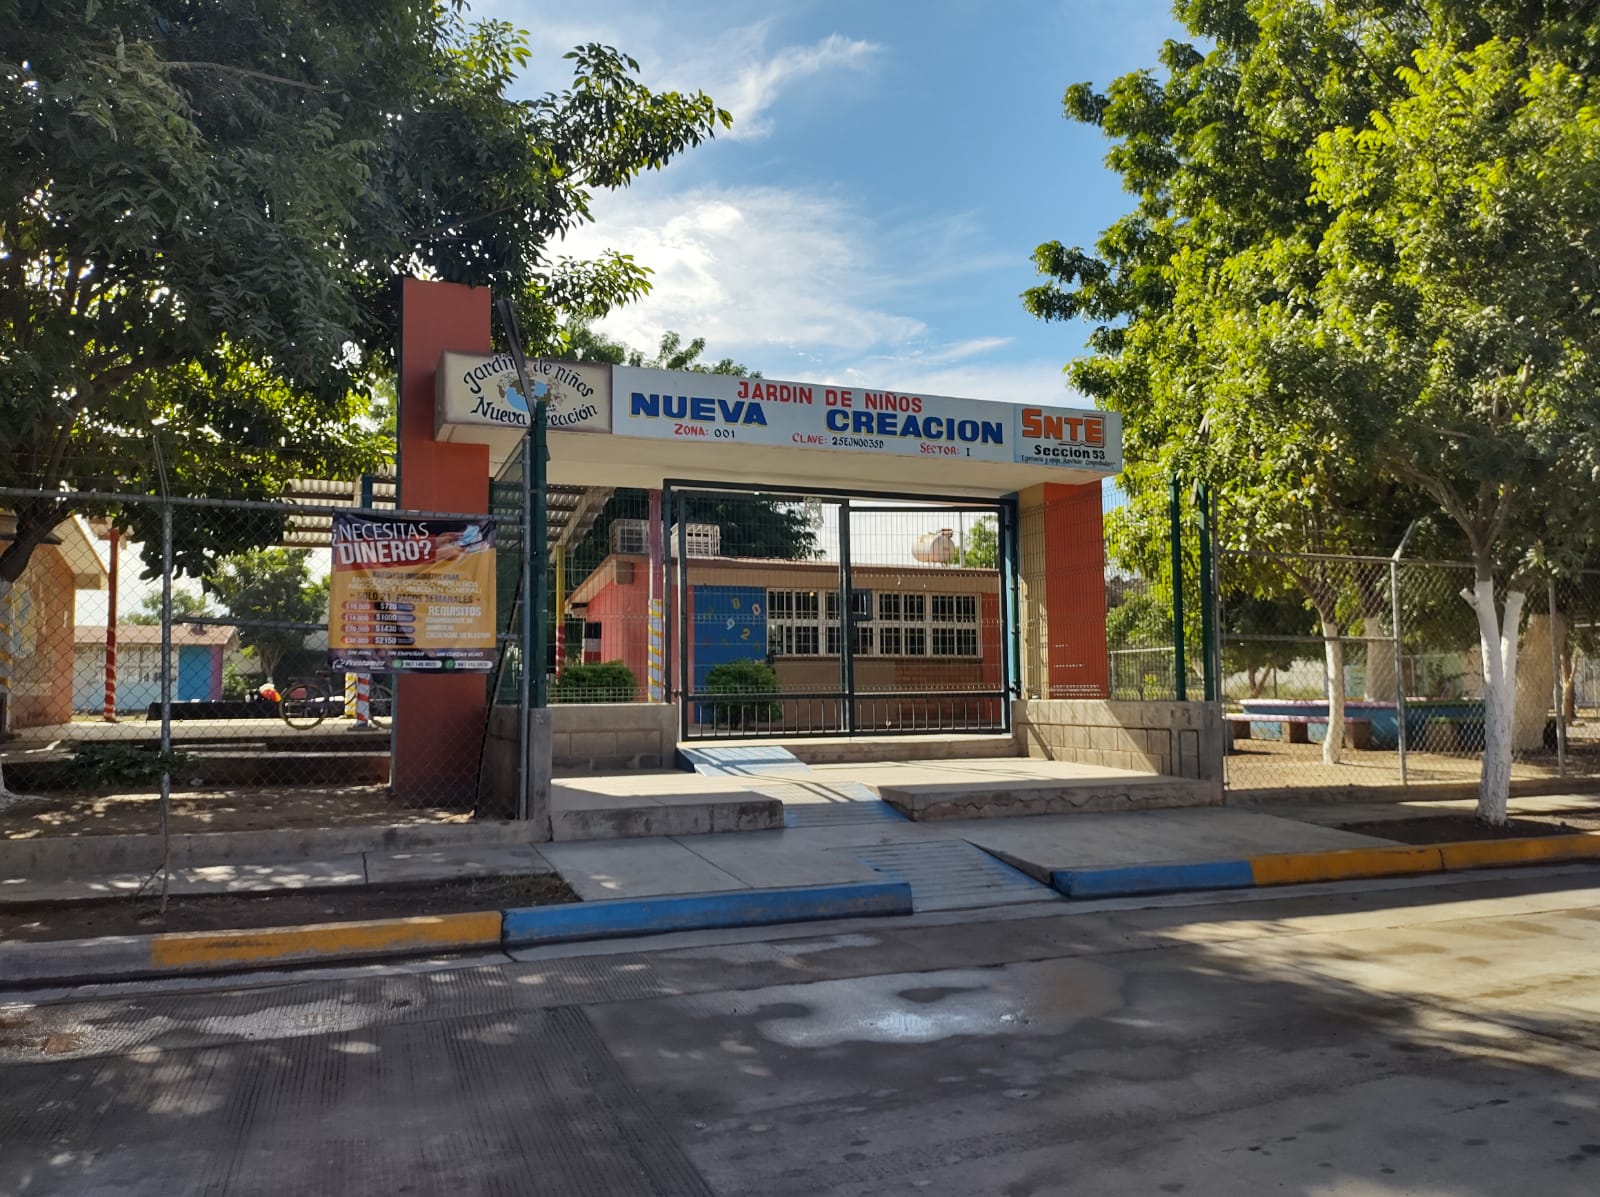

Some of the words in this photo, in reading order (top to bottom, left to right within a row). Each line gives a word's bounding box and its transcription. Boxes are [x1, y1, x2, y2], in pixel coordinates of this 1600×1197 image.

[533, 359, 552, 374] de
[556, 366, 594, 398] niños
[470, 396, 527, 425] Nueva
[737, 381, 813, 405] JARDIN
[825, 389, 852, 408] DE
[865, 391, 922, 413] NIÑOS
[630, 392, 768, 426] NUEVA
[826, 409, 1004, 444] CREACION
[1021, 407, 1103, 445] SNTE
[673, 423, 709, 437] ZONA:
[714, 428, 735, 439] 001
[792, 432, 827, 445] CLAVE:
[920, 442, 960, 456] SECTOR:
[1092, 450, 1106, 460] 53
[331, 522, 430, 546] ¿NECESITAS
[336, 540, 433, 565] DINERO?
[428, 605, 482, 617] REQUISITOS
